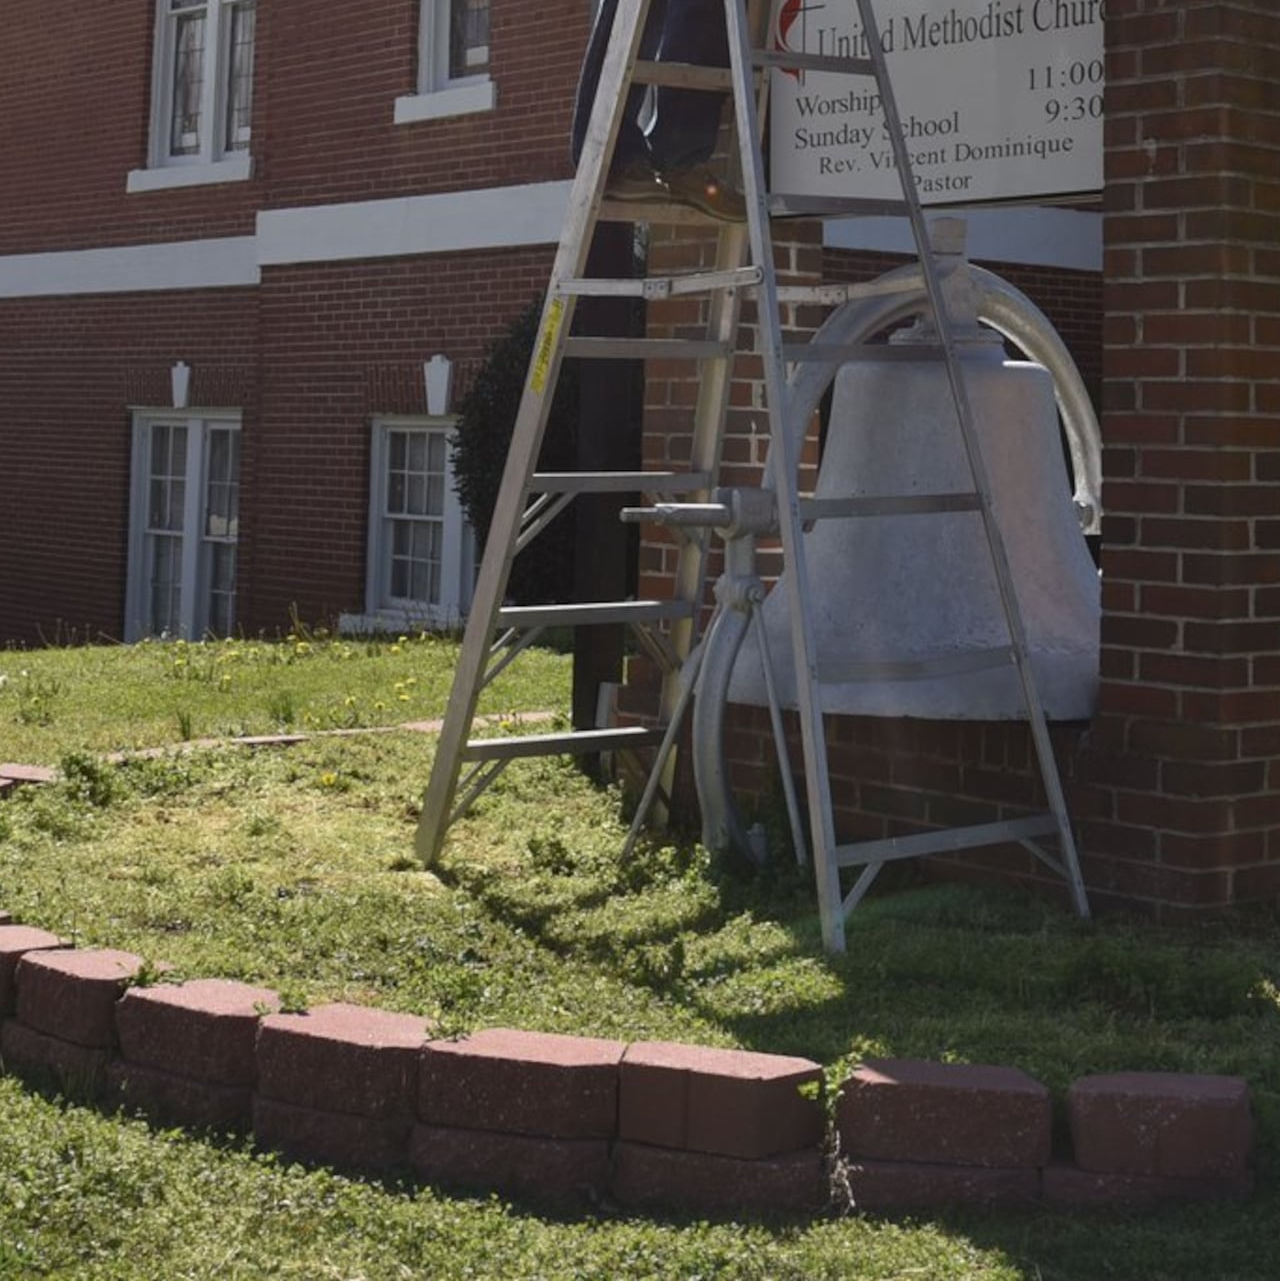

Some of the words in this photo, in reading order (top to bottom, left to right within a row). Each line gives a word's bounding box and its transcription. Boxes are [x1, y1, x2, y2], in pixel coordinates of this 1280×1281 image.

[817, 19, 894, 60] Unitd
[903, 0, 1024, 54] Methodist
[795, 89, 882, 117] Worship
[1029, 59, 1104, 90] 11:00
[795, 122, 876, 150] Sunday
[1045, 94, 1105, 123] 9:30
[819, 156, 862, 175] Rev.
[955, 134, 1075, 162] Dominique
